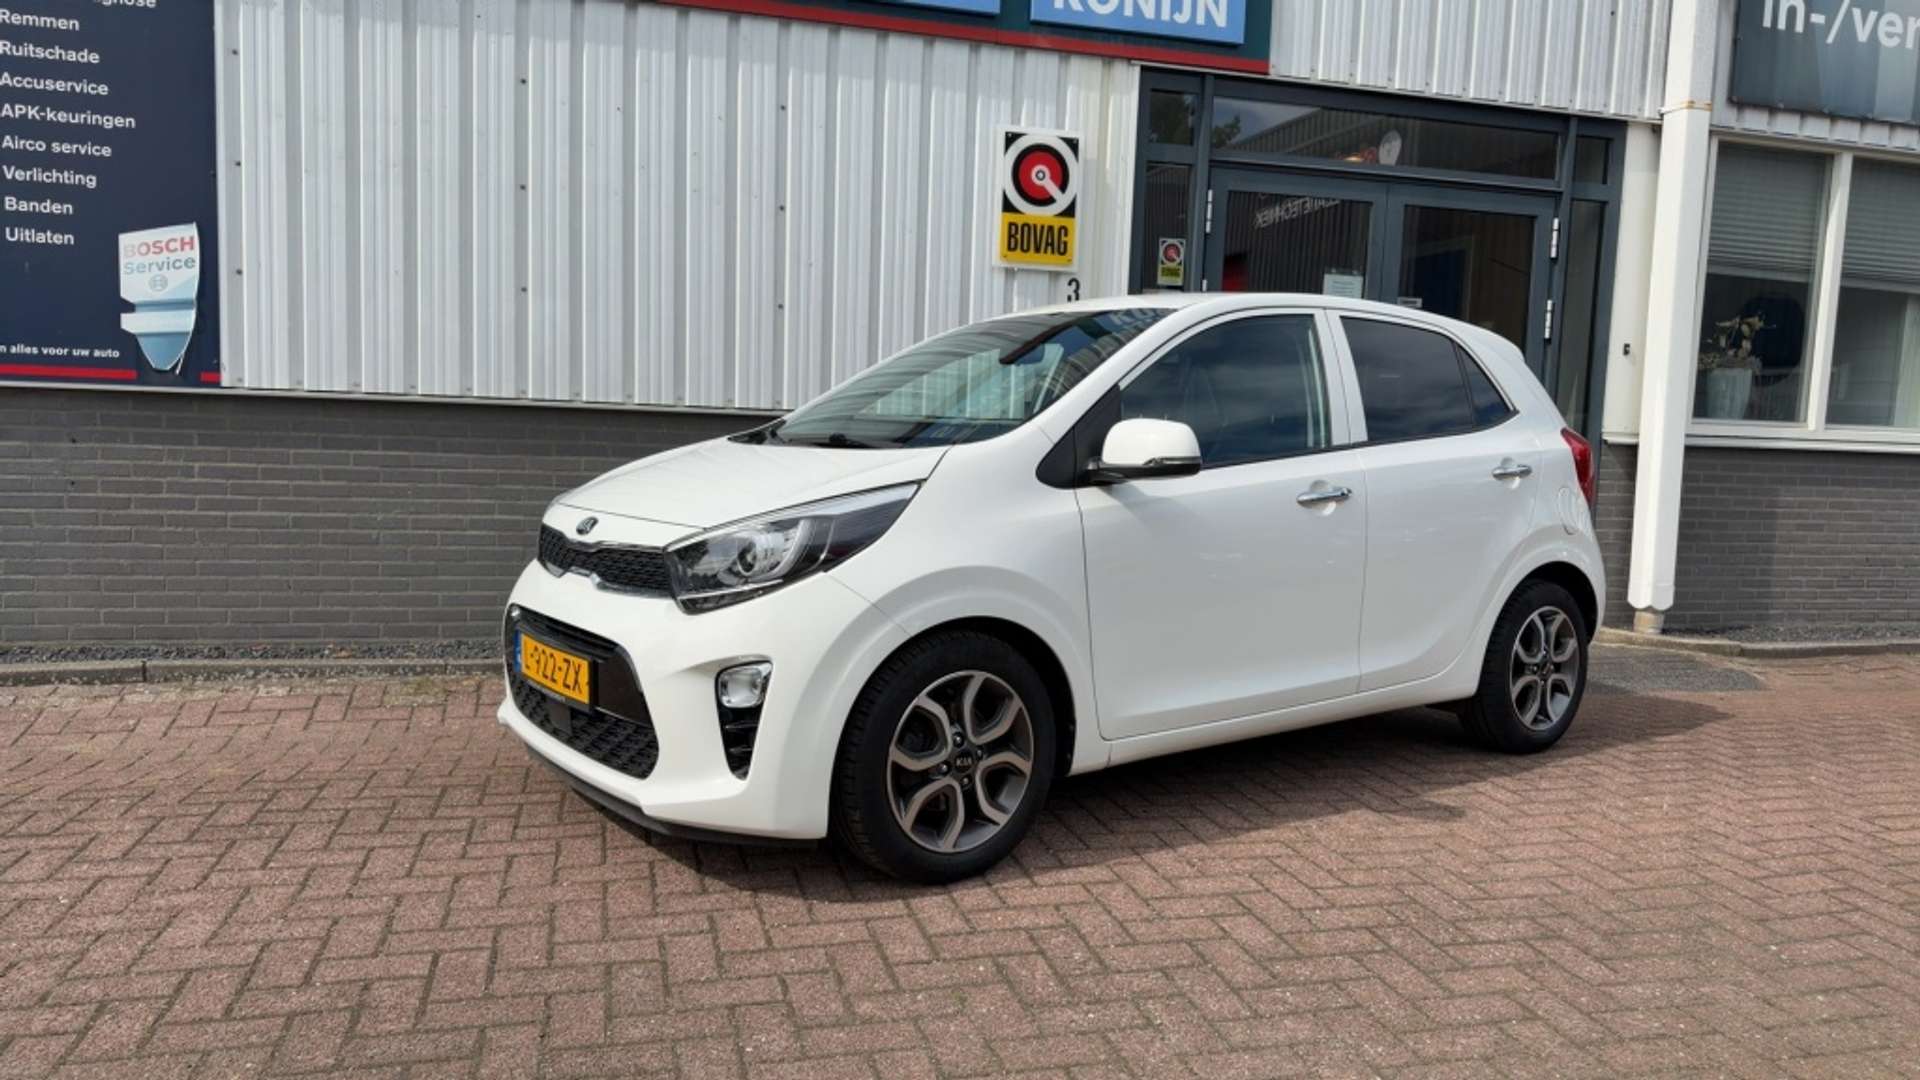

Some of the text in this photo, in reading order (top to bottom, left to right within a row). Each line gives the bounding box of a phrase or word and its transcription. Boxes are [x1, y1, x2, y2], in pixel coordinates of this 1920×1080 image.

[0, 8, 80, 32] Remmen
[0, 39, 101, 64] Ruitschade
[0, 71, 110, 96] Accuservice
[0, 102, 137, 129] APK-keuringen
[1, 135, 113, 157] Airco service
[2, 164, 97, 189] Verlichting
[4, 195, 74, 215] Banden
[5, 226, 75, 246] Uitlaten
[123, 235, 195, 257] BOSCH
[1007, 221, 1069, 256] BOVAG
[123, 256, 196, 275] Service
[1067, 277, 1081, 302] 3
[9, 343, 39, 355] alles
[41, 346, 69, 356] voor
[72, 348, 91, 357] uw
[93, 348, 120, 358] auto
